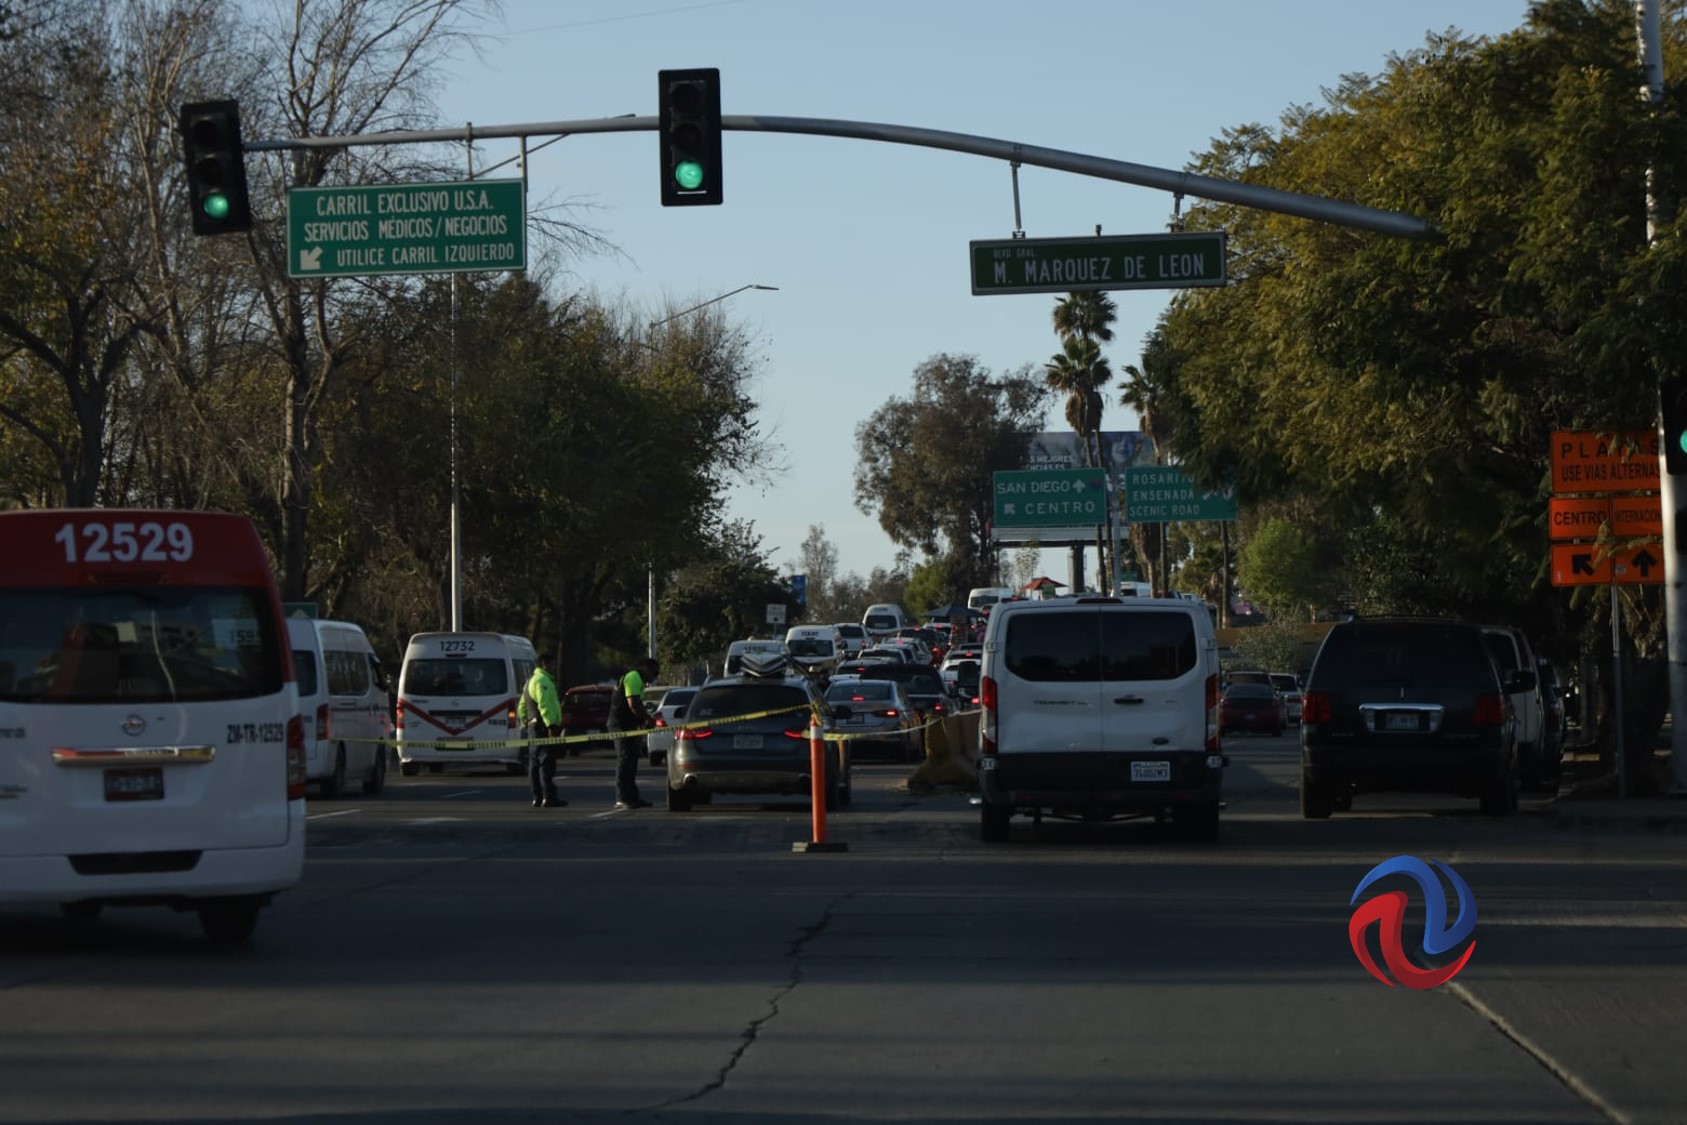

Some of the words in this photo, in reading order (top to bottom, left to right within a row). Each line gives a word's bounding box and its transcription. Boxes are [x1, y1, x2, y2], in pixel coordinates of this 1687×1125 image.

[316, 195, 371, 216] CARRIL
[378, 191, 449, 214] EXCLUSIVO
[454, 190, 494, 211] U.S.A.
[304, 220, 369, 243] SERVICIOS
[337, 248, 385, 267] UTILICE
[392, 246, 438, 265] CARRIL
[445, 242, 514, 263] IZQUIERDO
[994, 262, 1012, 284] M.
[1025, 257, 1111, 282] MARQUEZ
[1124, 255, 1145, 279] DE
[1159, 253, 1204, 278] LEON
[1562, 464, 1581, 482] USE
[1584, 463, 1607, 481] VIAS
[996, 482, 1027, 495] SAN
[1030, 480, 1071, 494] DIEGO
[1133, 489, 1195, 501] ENSENADA
[1025, 501, 1096, 515] CENTRO
[1129, 505, 1168, 517] SCENIC
[1171, 504, 1200, 516] ROAD
[1554, 511, 1607, 526] CENTRO
[54, 522, 194, 563] 12529
[439, 640, 476, 651] 12732
